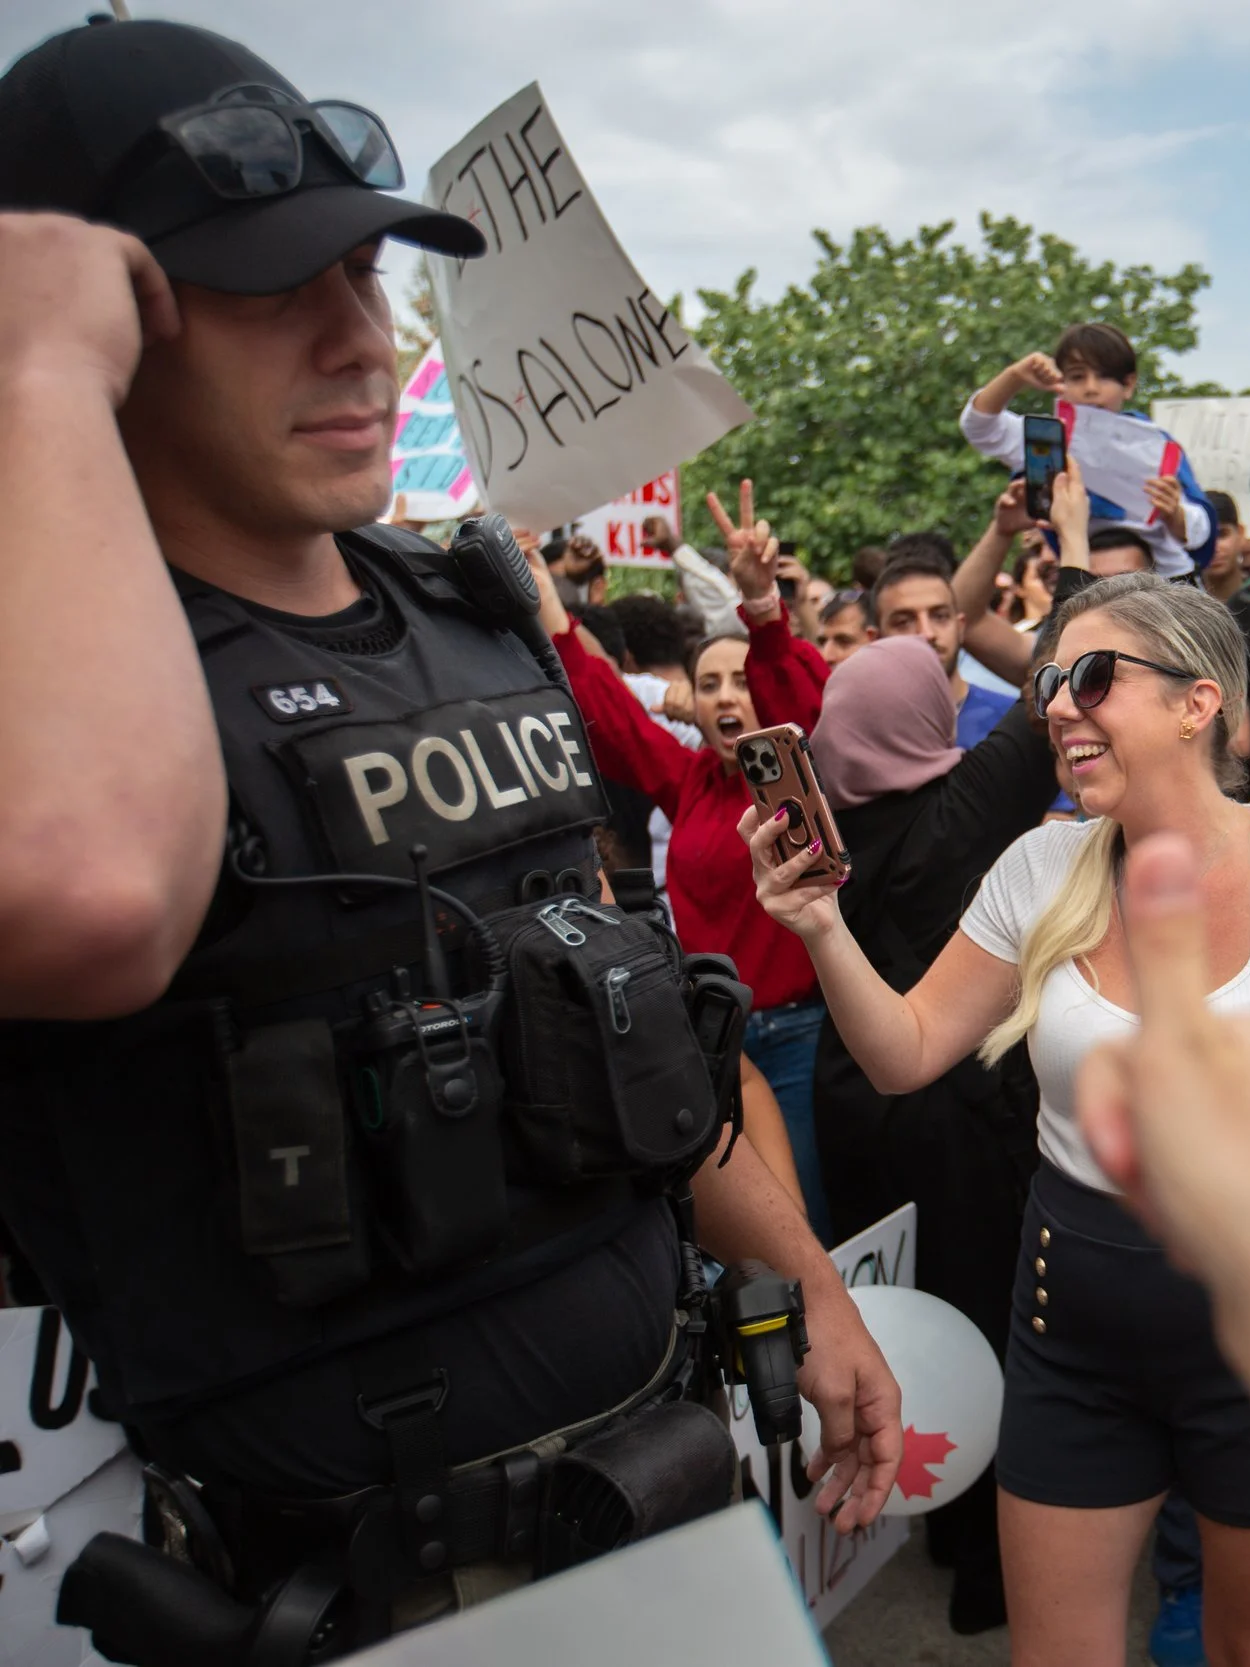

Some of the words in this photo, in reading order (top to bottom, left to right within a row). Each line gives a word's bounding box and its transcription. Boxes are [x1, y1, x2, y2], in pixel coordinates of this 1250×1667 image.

[458, 105, 582, 252] THE
[457, 359, 527, 486] DS
[517, 289, 690, 446] ALONE
[268, 677, 341, 714] 654
[343, 711, 593, 846] POLICE
[269, 1144, 310, 1186] T
